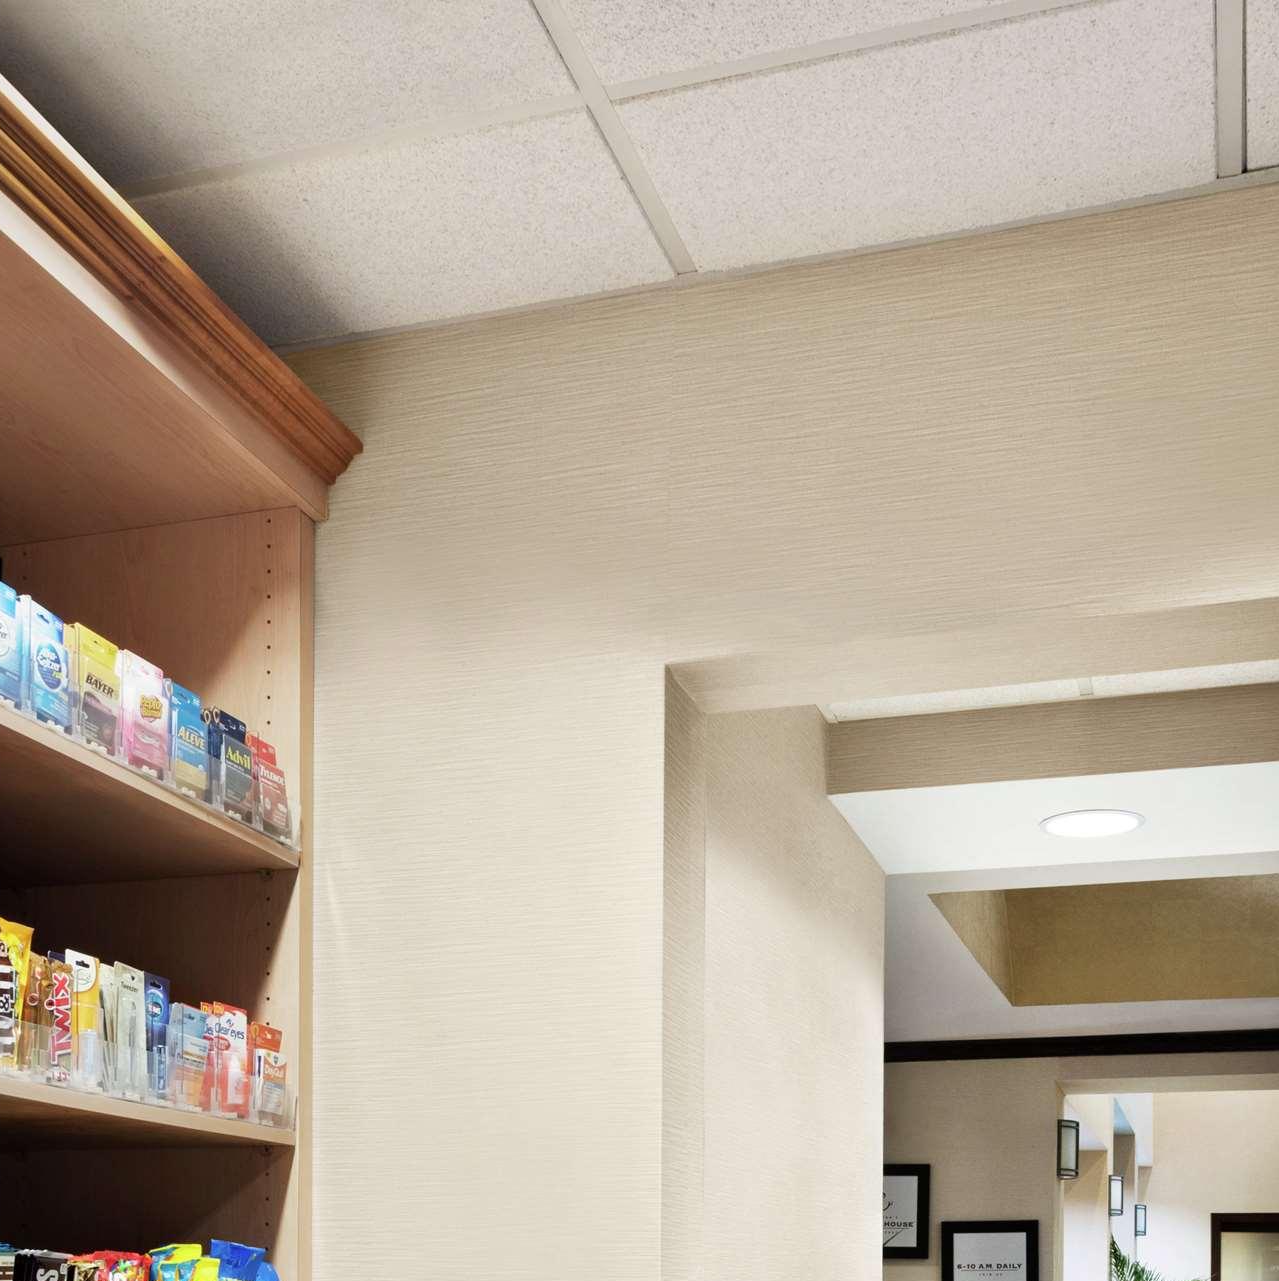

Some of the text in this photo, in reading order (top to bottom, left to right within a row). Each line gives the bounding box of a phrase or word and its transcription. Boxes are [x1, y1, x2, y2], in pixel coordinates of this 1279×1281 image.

[86, 673, 114, 698] BAYER
[178, 727, 206, 750] ALEVE
[227, 746, 251, 769] Advil
[996, 1262, 1023, 1270] DAILY
